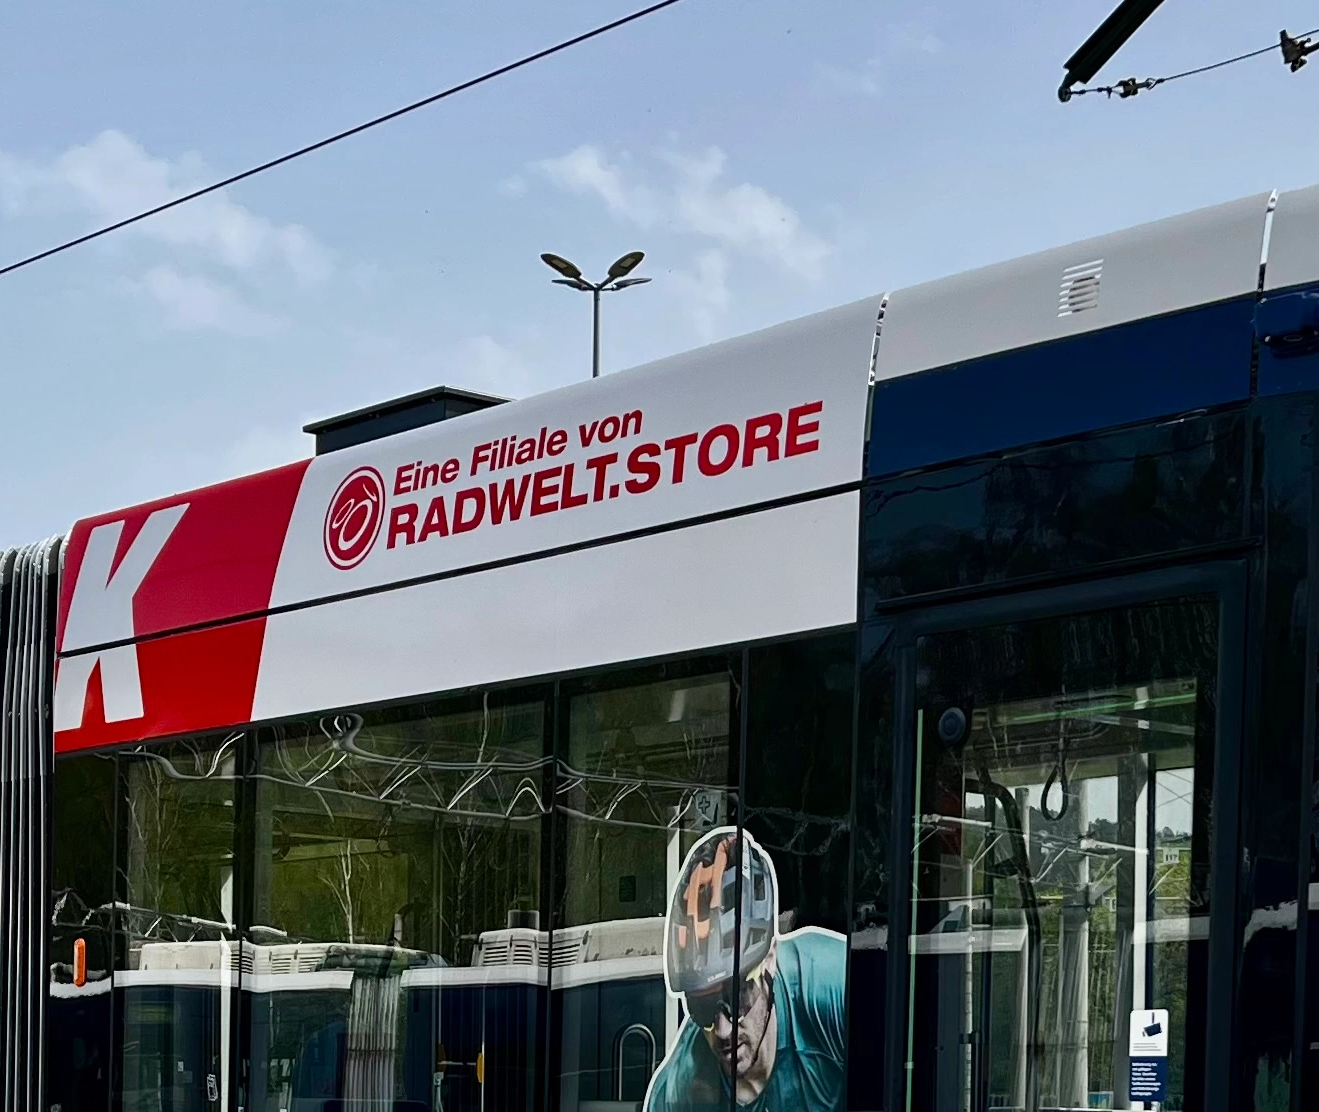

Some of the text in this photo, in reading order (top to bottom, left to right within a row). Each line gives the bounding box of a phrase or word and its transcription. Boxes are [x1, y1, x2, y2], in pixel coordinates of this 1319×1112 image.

[386, 400, 824, 550] RADWELT.STORE
[393, 409, 643, 496] Eine Filiale von
